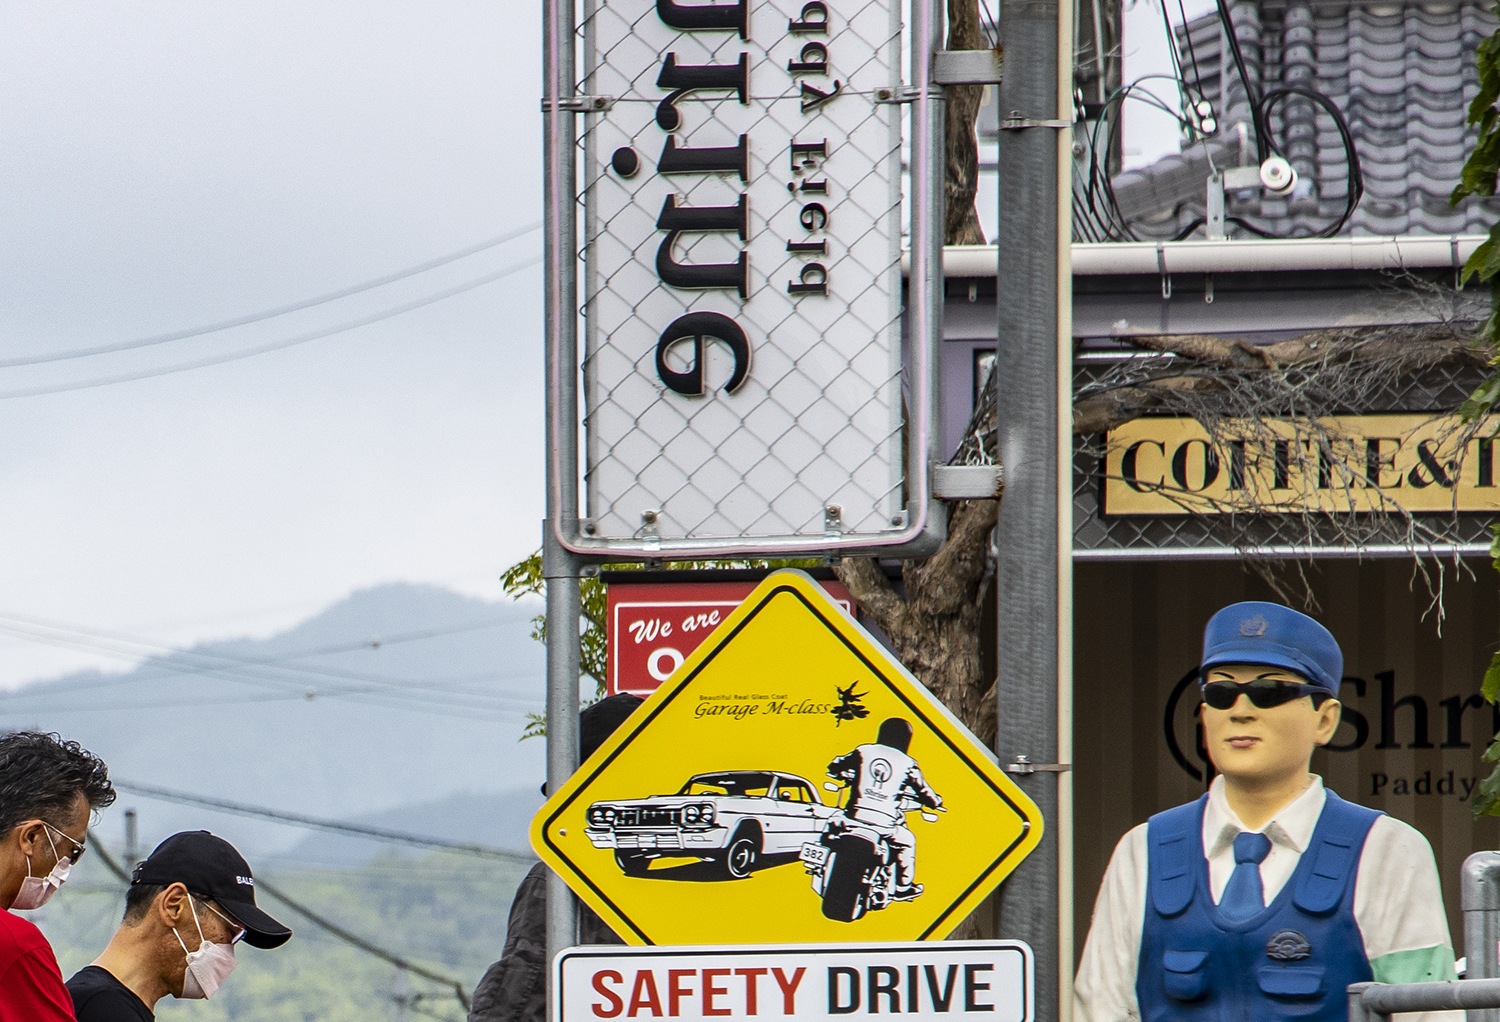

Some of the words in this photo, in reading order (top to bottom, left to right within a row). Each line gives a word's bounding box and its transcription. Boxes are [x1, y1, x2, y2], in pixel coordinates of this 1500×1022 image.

[628, 617, 673, 644] We
[681, 609, 721, 633] are
[694, 702, 759, 720] Garage
[762, 699, 831, 716] M-class
[1370, 770, 1478, 802] Paddy
[803, 847, 823, 860] 382
[591, 966, 807, 1020] SAFETY
[827, 962, 996, 1014] DRIVE
